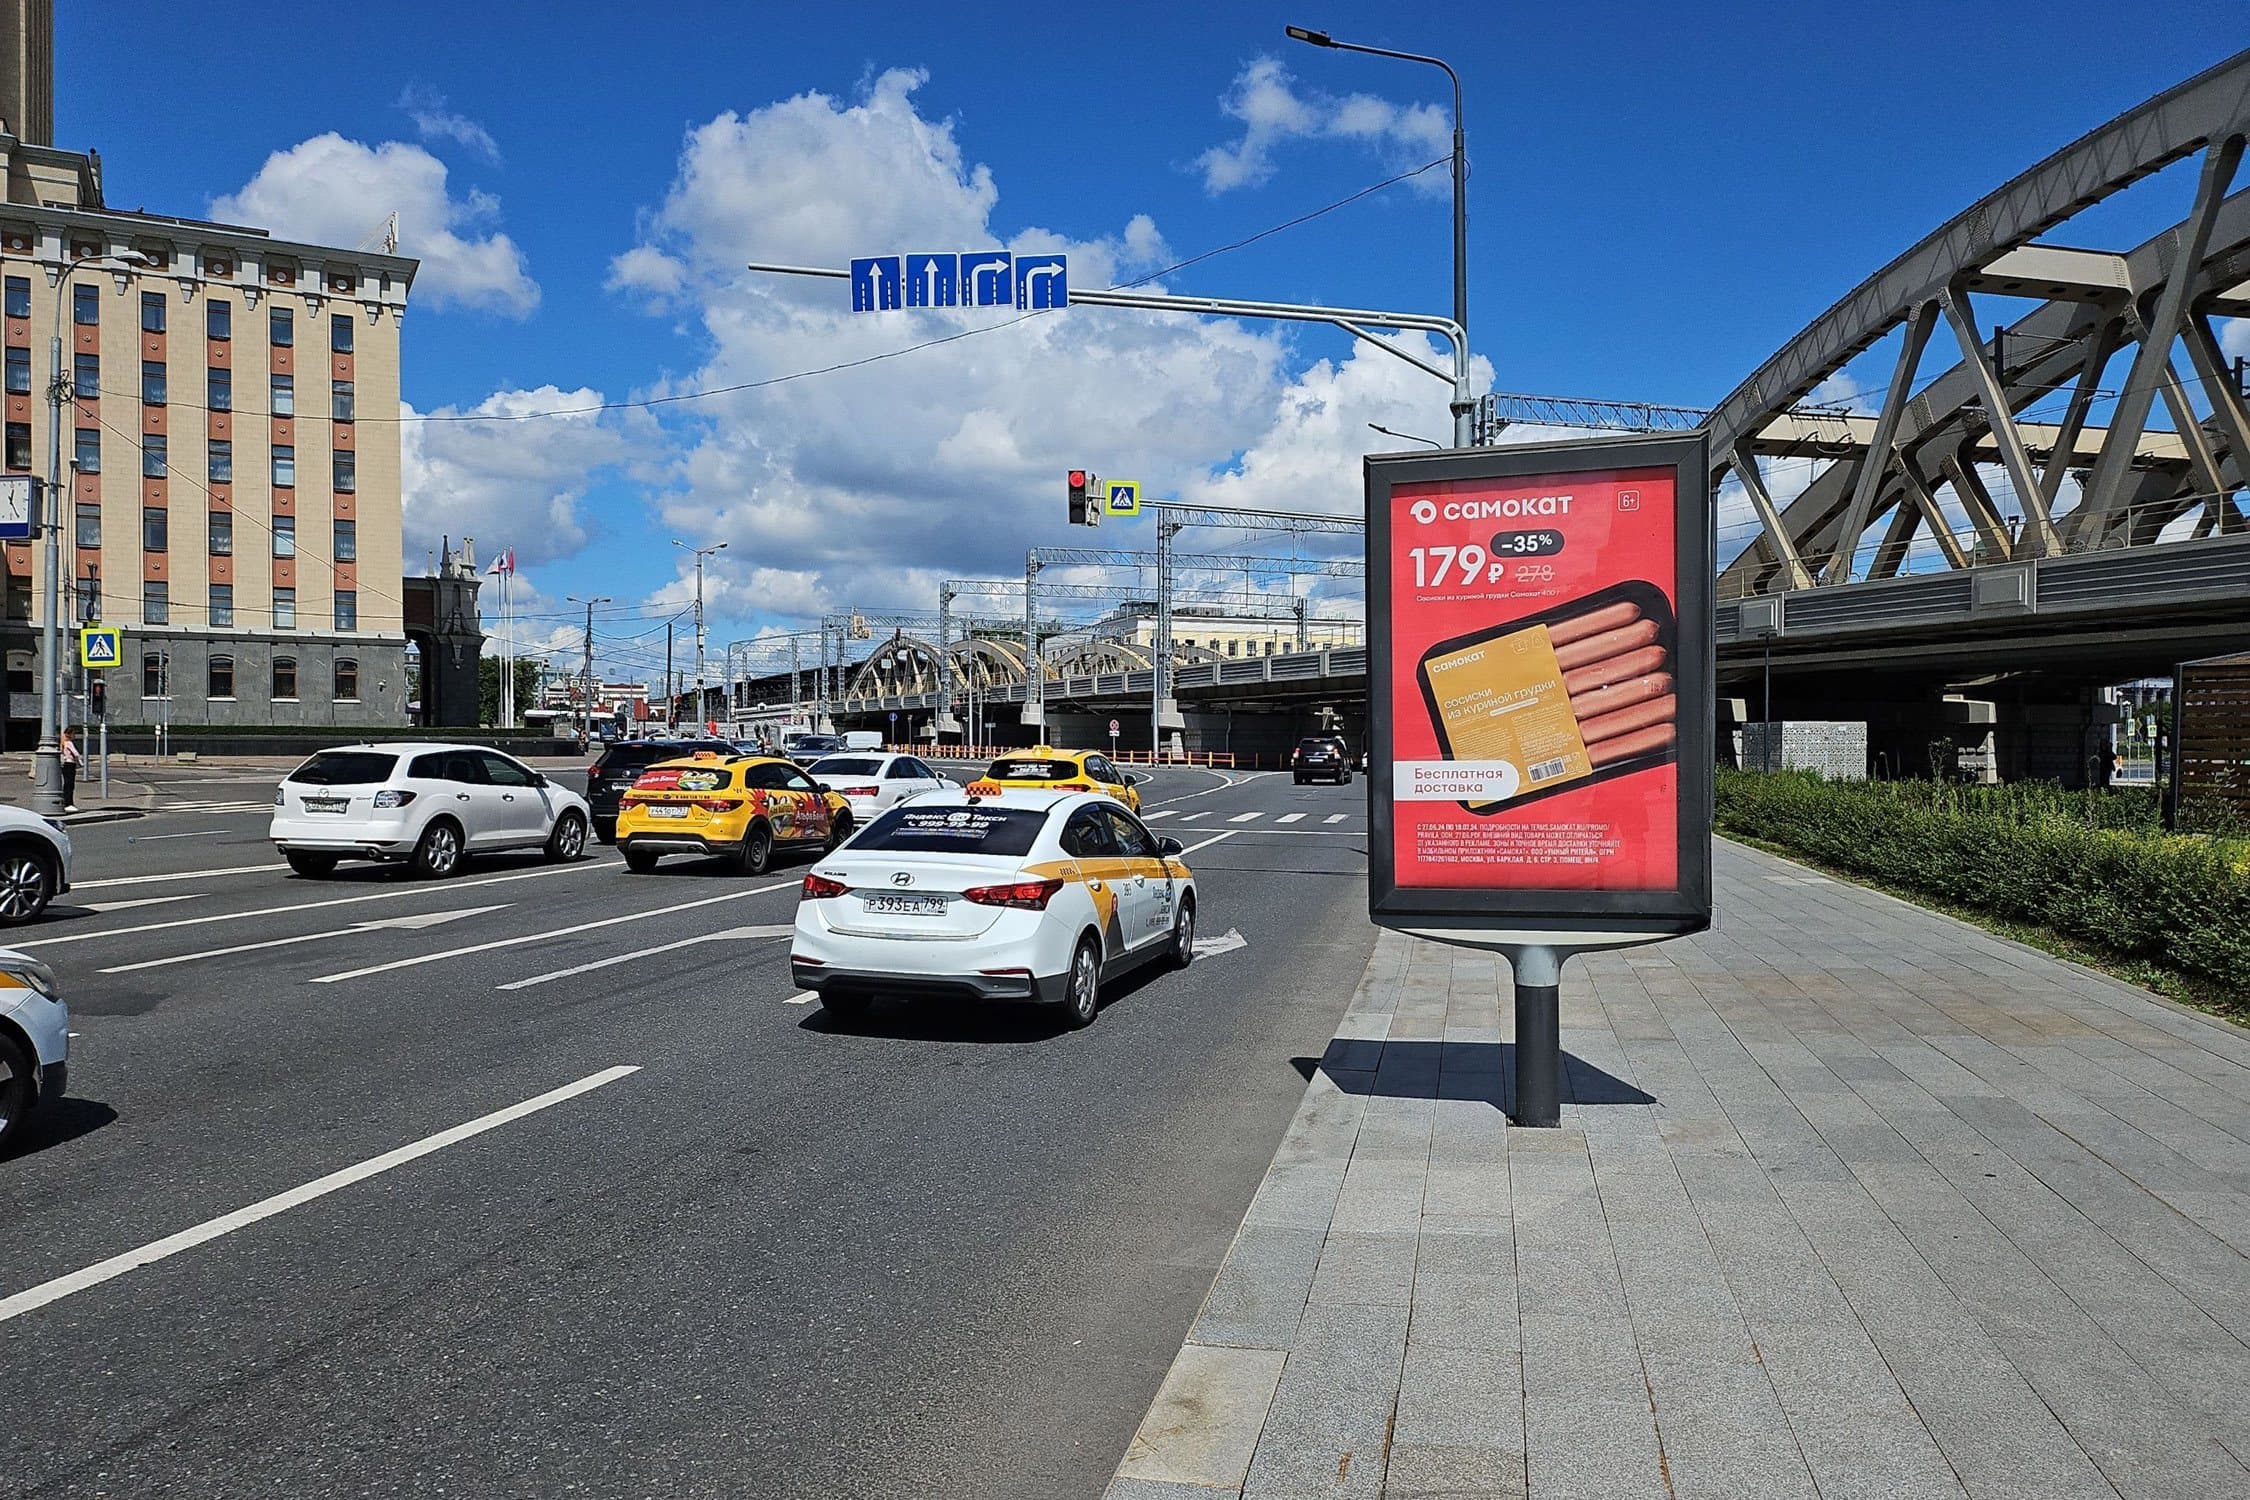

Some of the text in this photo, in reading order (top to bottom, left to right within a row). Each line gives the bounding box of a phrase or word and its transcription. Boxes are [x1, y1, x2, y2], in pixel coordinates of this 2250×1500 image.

[1622, 494, 1636, 507] 6+
[1443, 495, 1573, 521] самокат
[1456, 592, 1485, 601] куриной
[1486, 593, 1510, 601] грудки
[1432, 650, 1487, 673] самокат
[1444, 688, 1493, 709] сосиски
[1447, 709, 1462, 720] из
[1463, 692, 1512, 715] куриной
[1514, 680, 1557, 700] грудки
[1414, 767, 1504, 780] Бесплатная
[1414, 783, 1484, 795] доставка
[902, 813, 947, 821] Яндекс
[972, 814, 1008, 822] Такси
[924, 897, 944, 909] 799
